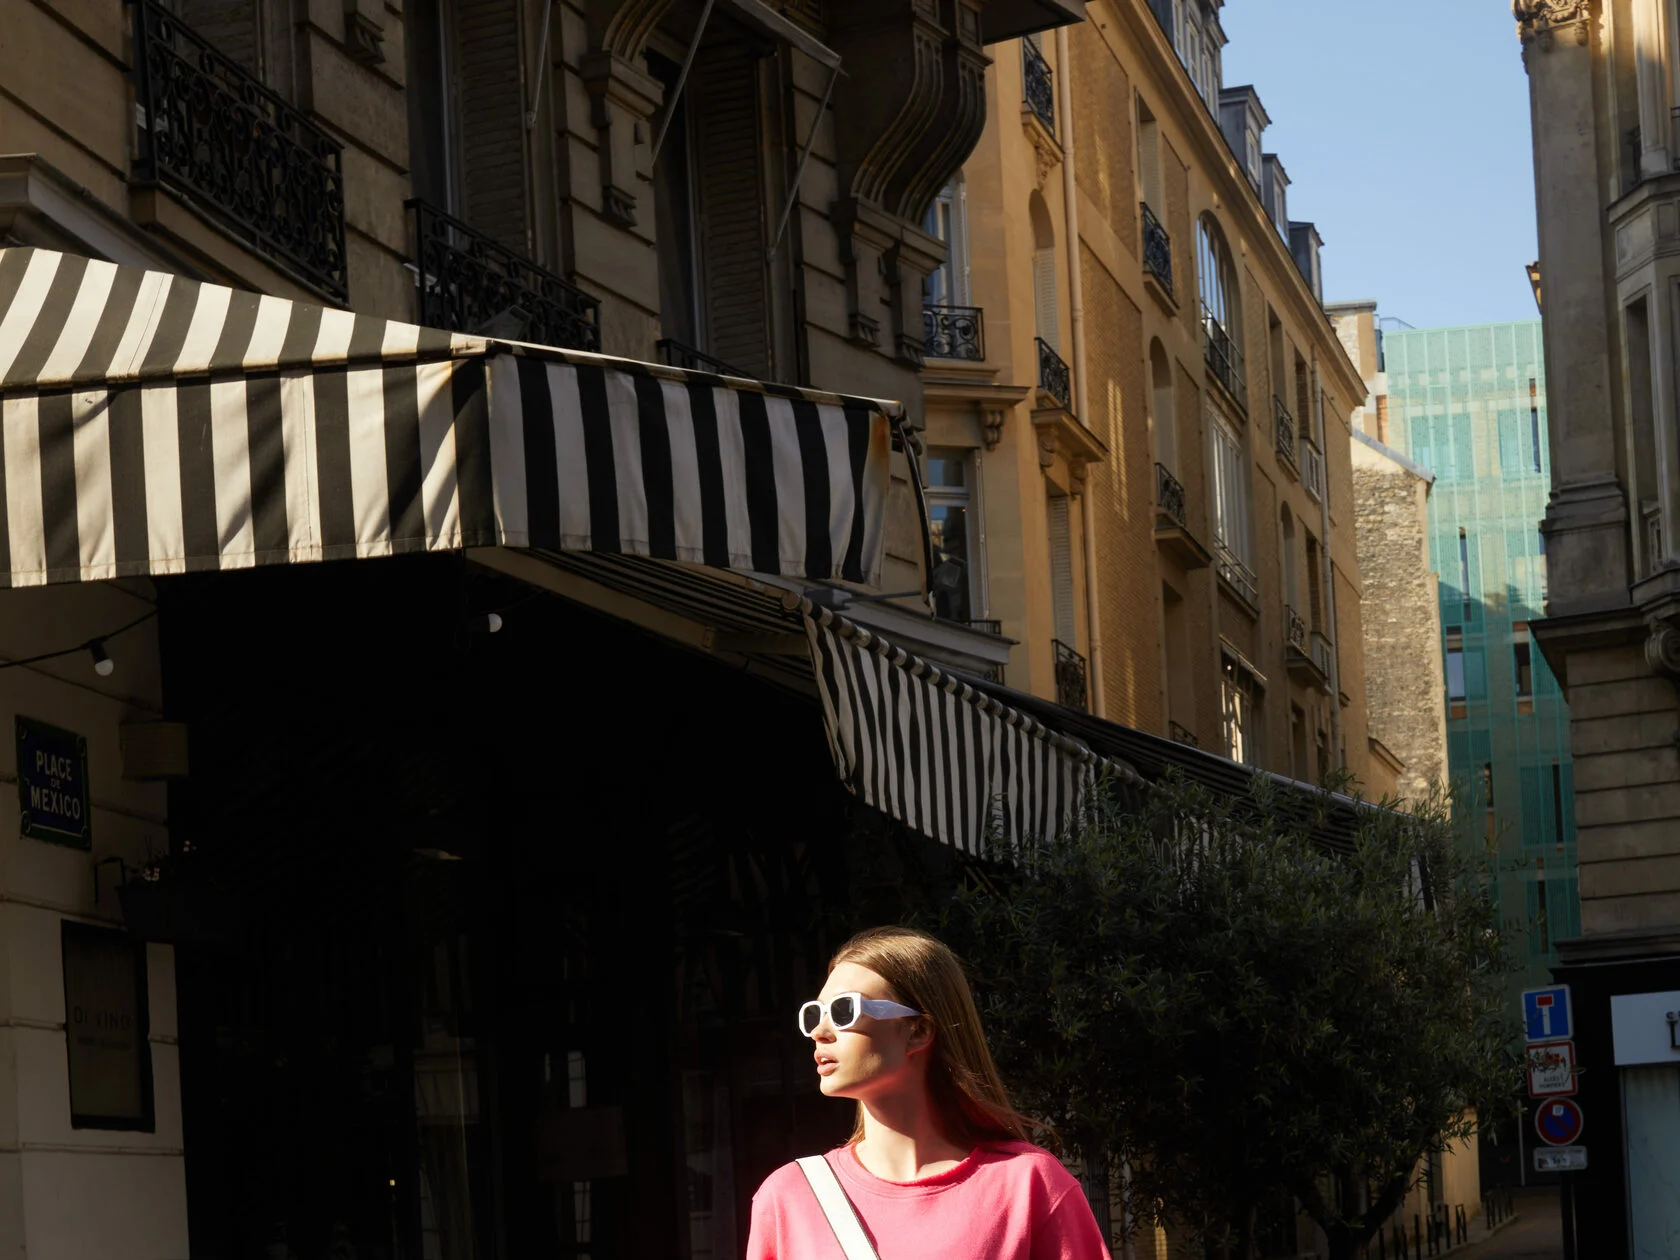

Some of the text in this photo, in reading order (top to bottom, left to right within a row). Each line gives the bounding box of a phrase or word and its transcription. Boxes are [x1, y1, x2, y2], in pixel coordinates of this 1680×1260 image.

[36, 750, 73, 782] PLACE
[51, 778, 62, 790] DE
[30, 784, 81, 821] MEXICO
